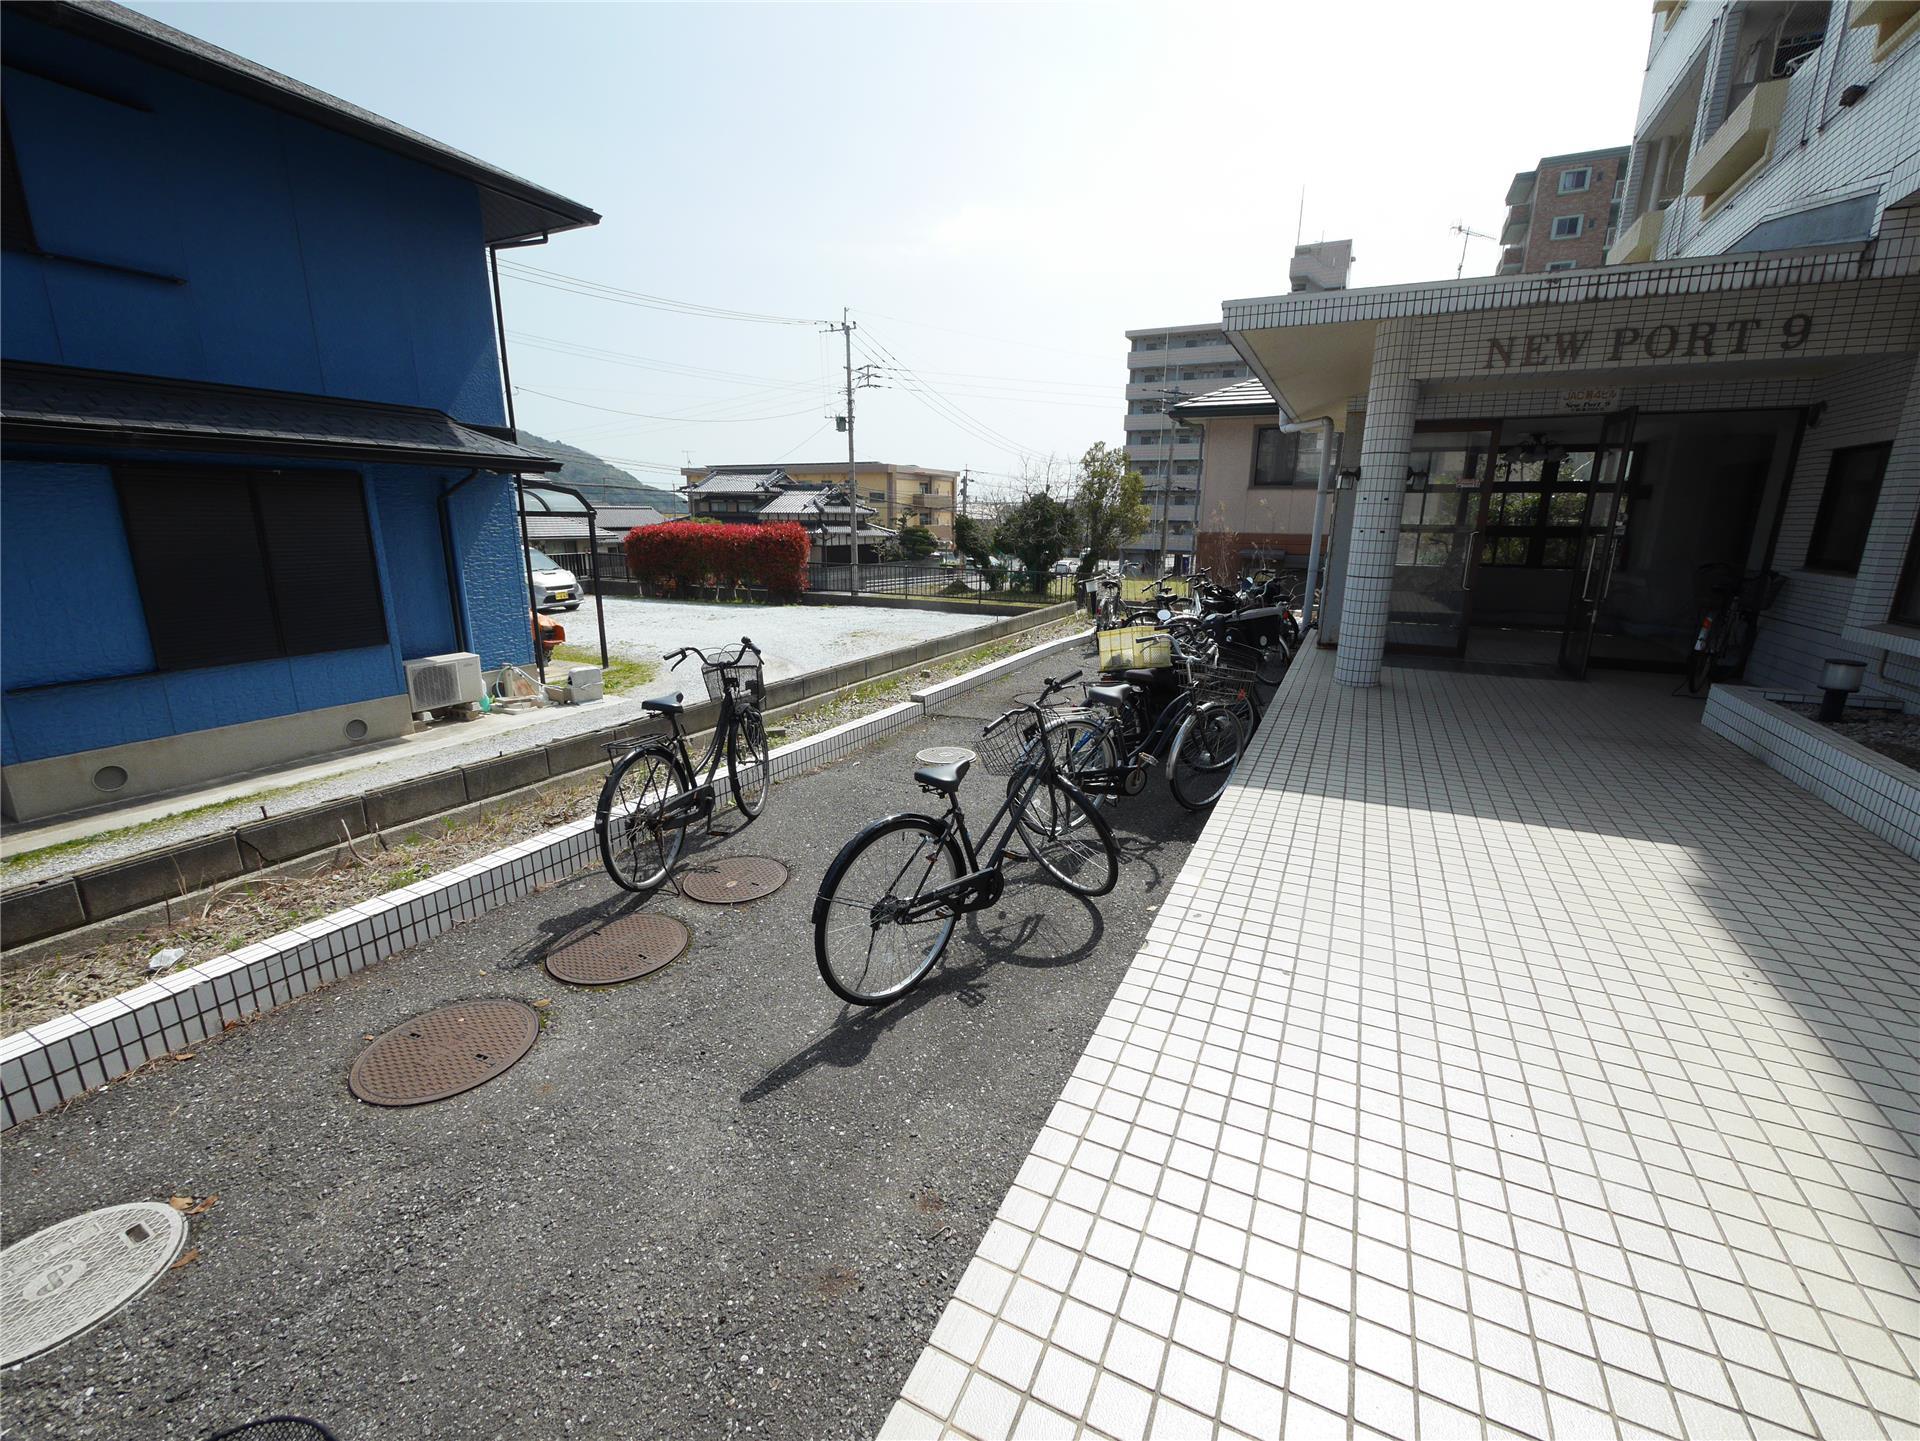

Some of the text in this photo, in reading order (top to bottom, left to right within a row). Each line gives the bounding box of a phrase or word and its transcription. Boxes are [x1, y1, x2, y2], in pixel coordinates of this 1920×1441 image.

[1483, 313, 1812, 369] NEW PORT 9
